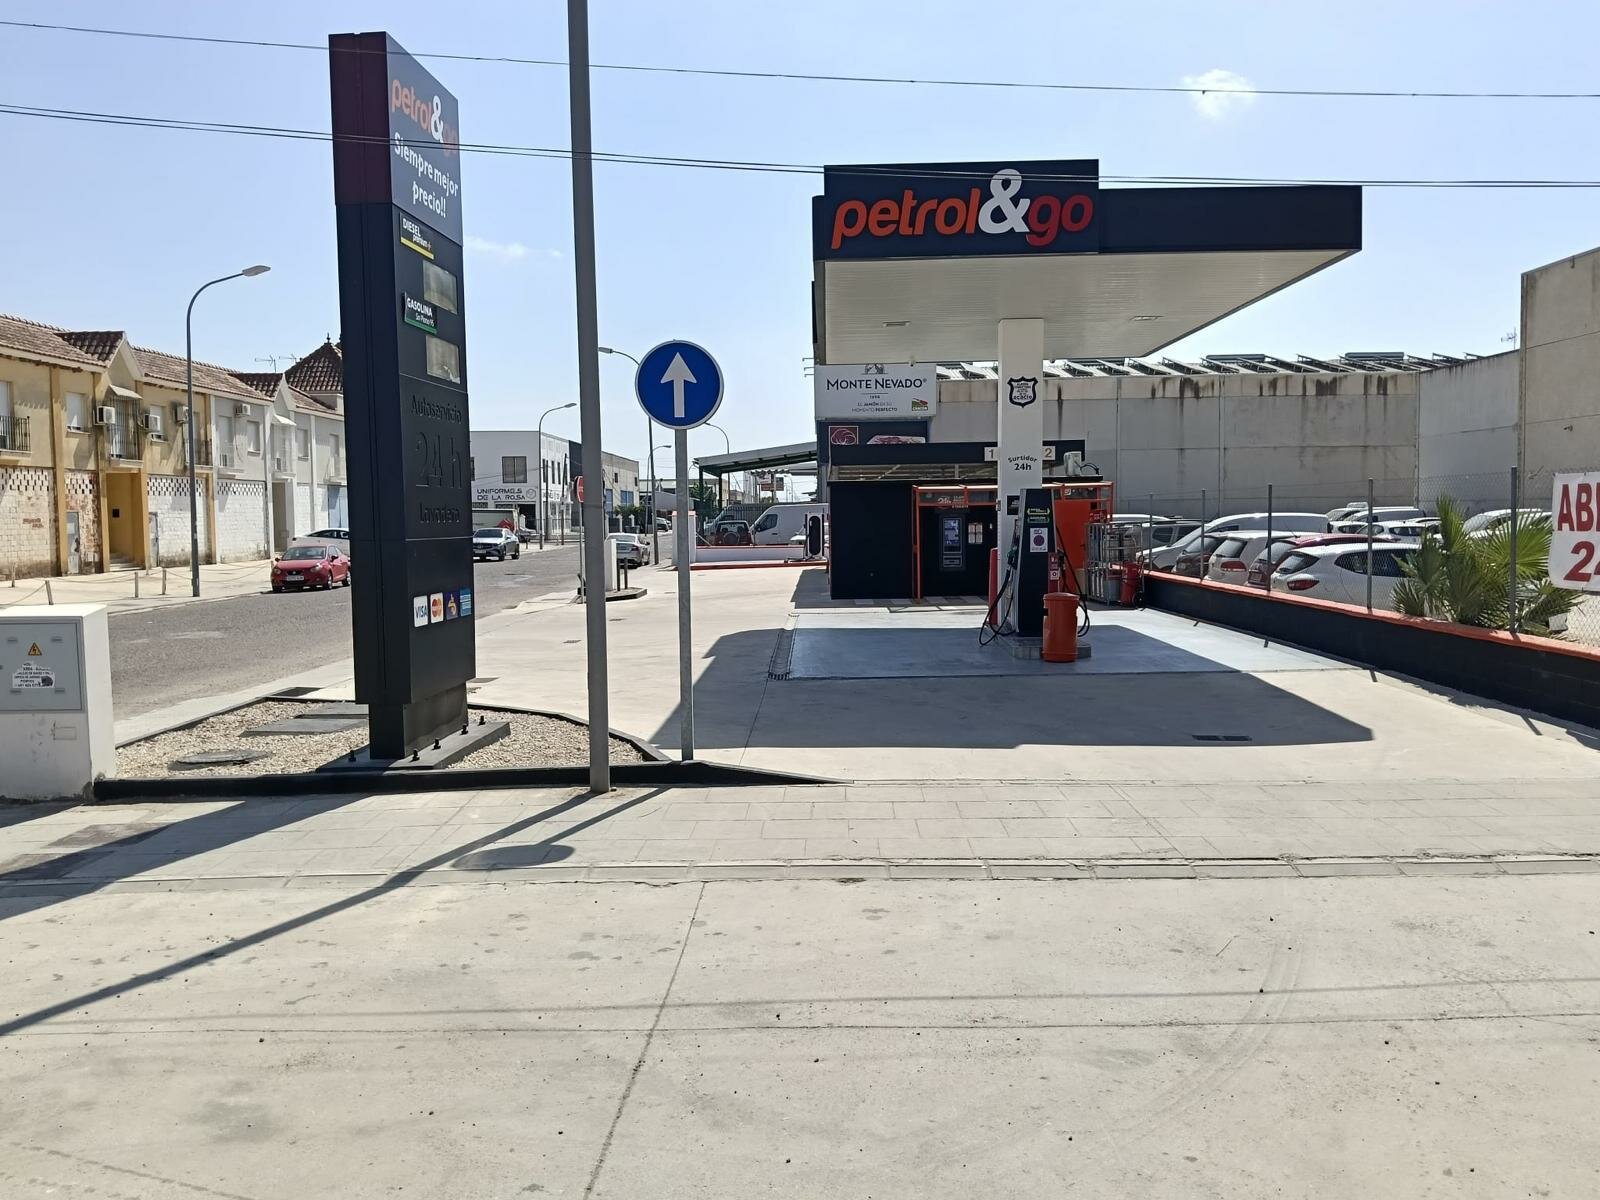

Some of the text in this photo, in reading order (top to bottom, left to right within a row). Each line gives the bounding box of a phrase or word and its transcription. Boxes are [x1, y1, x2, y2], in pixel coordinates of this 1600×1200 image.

[394, 132, 459, 197] Siempre mejor
[412, 180, 446, 218] precio!!
[831, 168, 1094, 250] petrol&go
[402, 217, 421, 237] DIESEL
[406, 297, 433, 318] GASOLINA
[826, 378, 872, 390] MONTE
[988, 449, 995, 460] 1
[1007, 454, 1038, 463] Surtidor
[1044, 448, 1053, 459] 2
[1014, 463, 1032, 471] 24h
[1557, 482, 1600, 532] AB
[1563, 540, 1600, 582] 2
[414, 604, 428, 619] VISA
